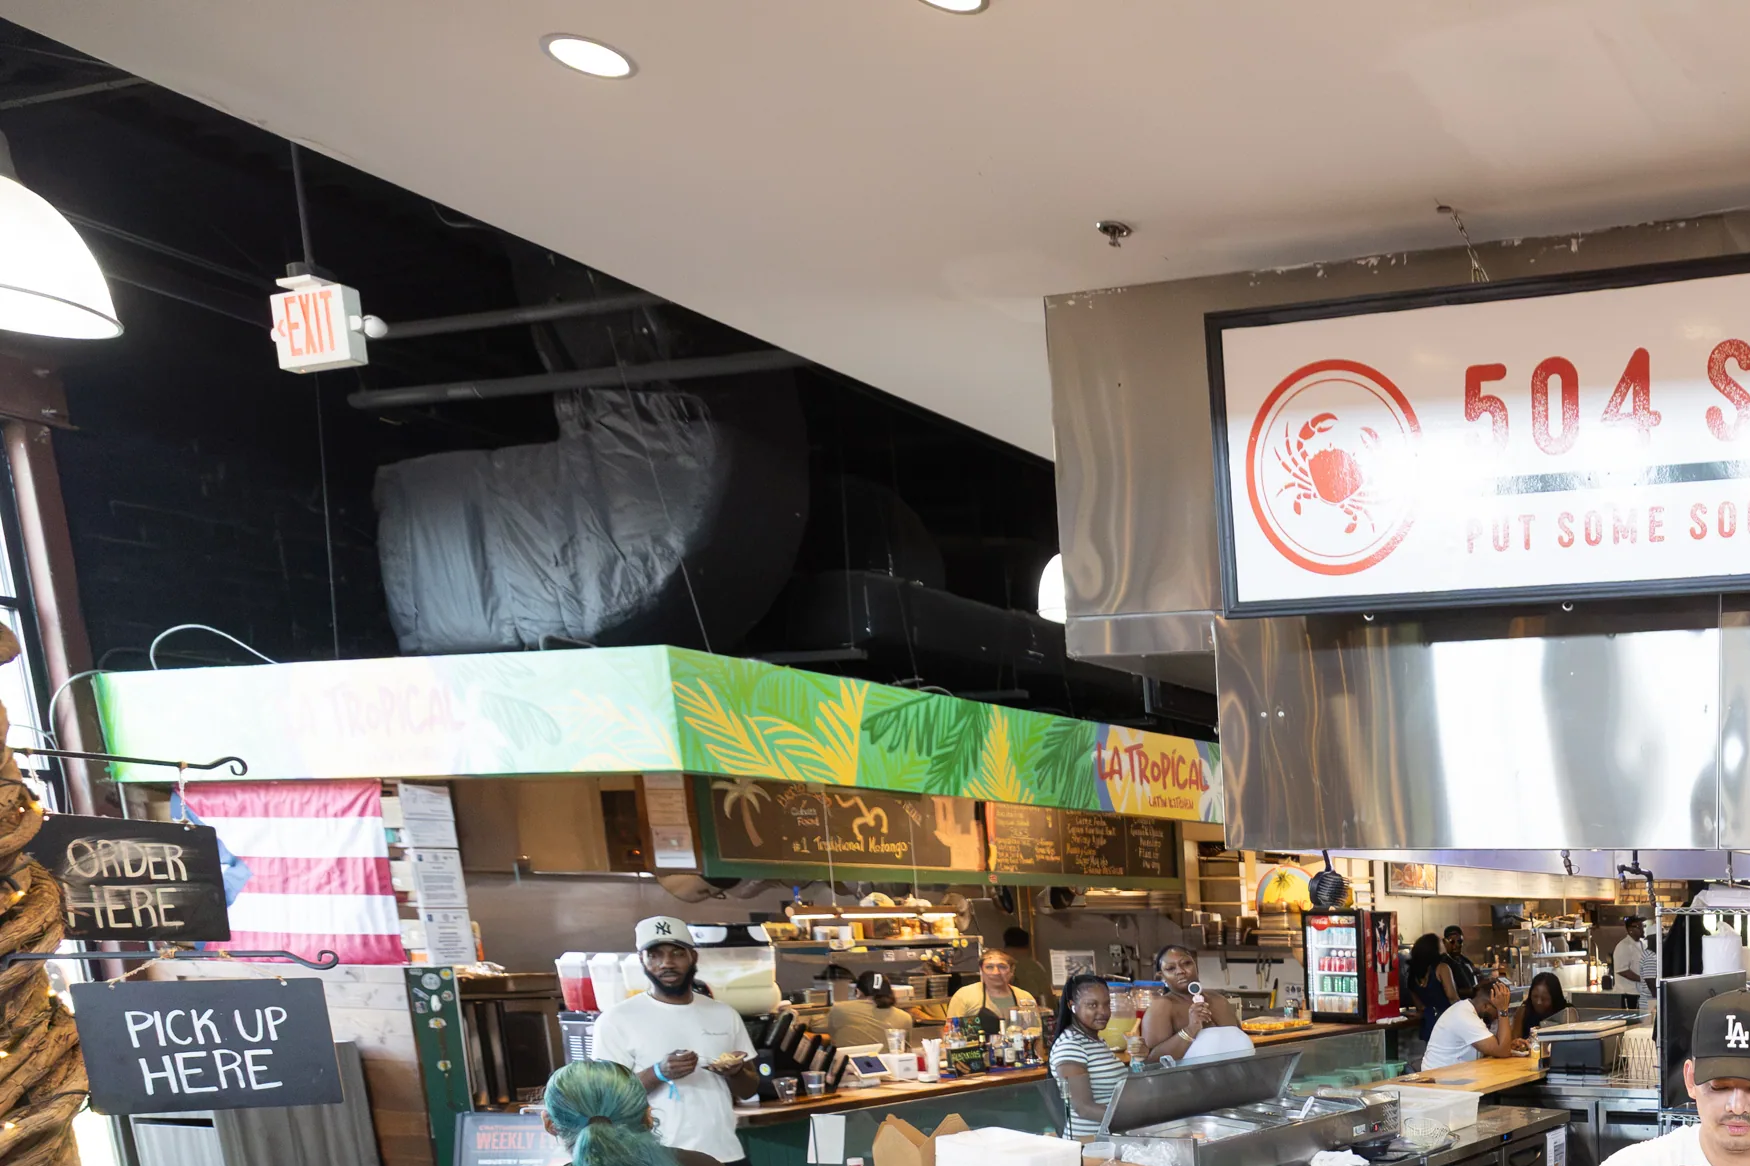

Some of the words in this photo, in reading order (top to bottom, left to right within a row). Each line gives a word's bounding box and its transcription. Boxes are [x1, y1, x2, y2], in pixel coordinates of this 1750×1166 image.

[284, 290, 335, 357] EXIT
[1464, 347, 1662, 458] 504
[1465, 513, 1536, 554] PUT
[1557, 505, 1665, 549] SOME
[1096, 741, 1123, 780] LA
[66, 838, 188, 882] ORDER
[62, 881, 185, 929] HERE
[124, 1009, 221, 1048] PICK
[234, 1006, 288, 1043] UP
[1725, 1014, 1750, 1049] LA
[138, 1048, 283, 1096] HERE
[476, 1131, 535, 1150] WEEKLY
